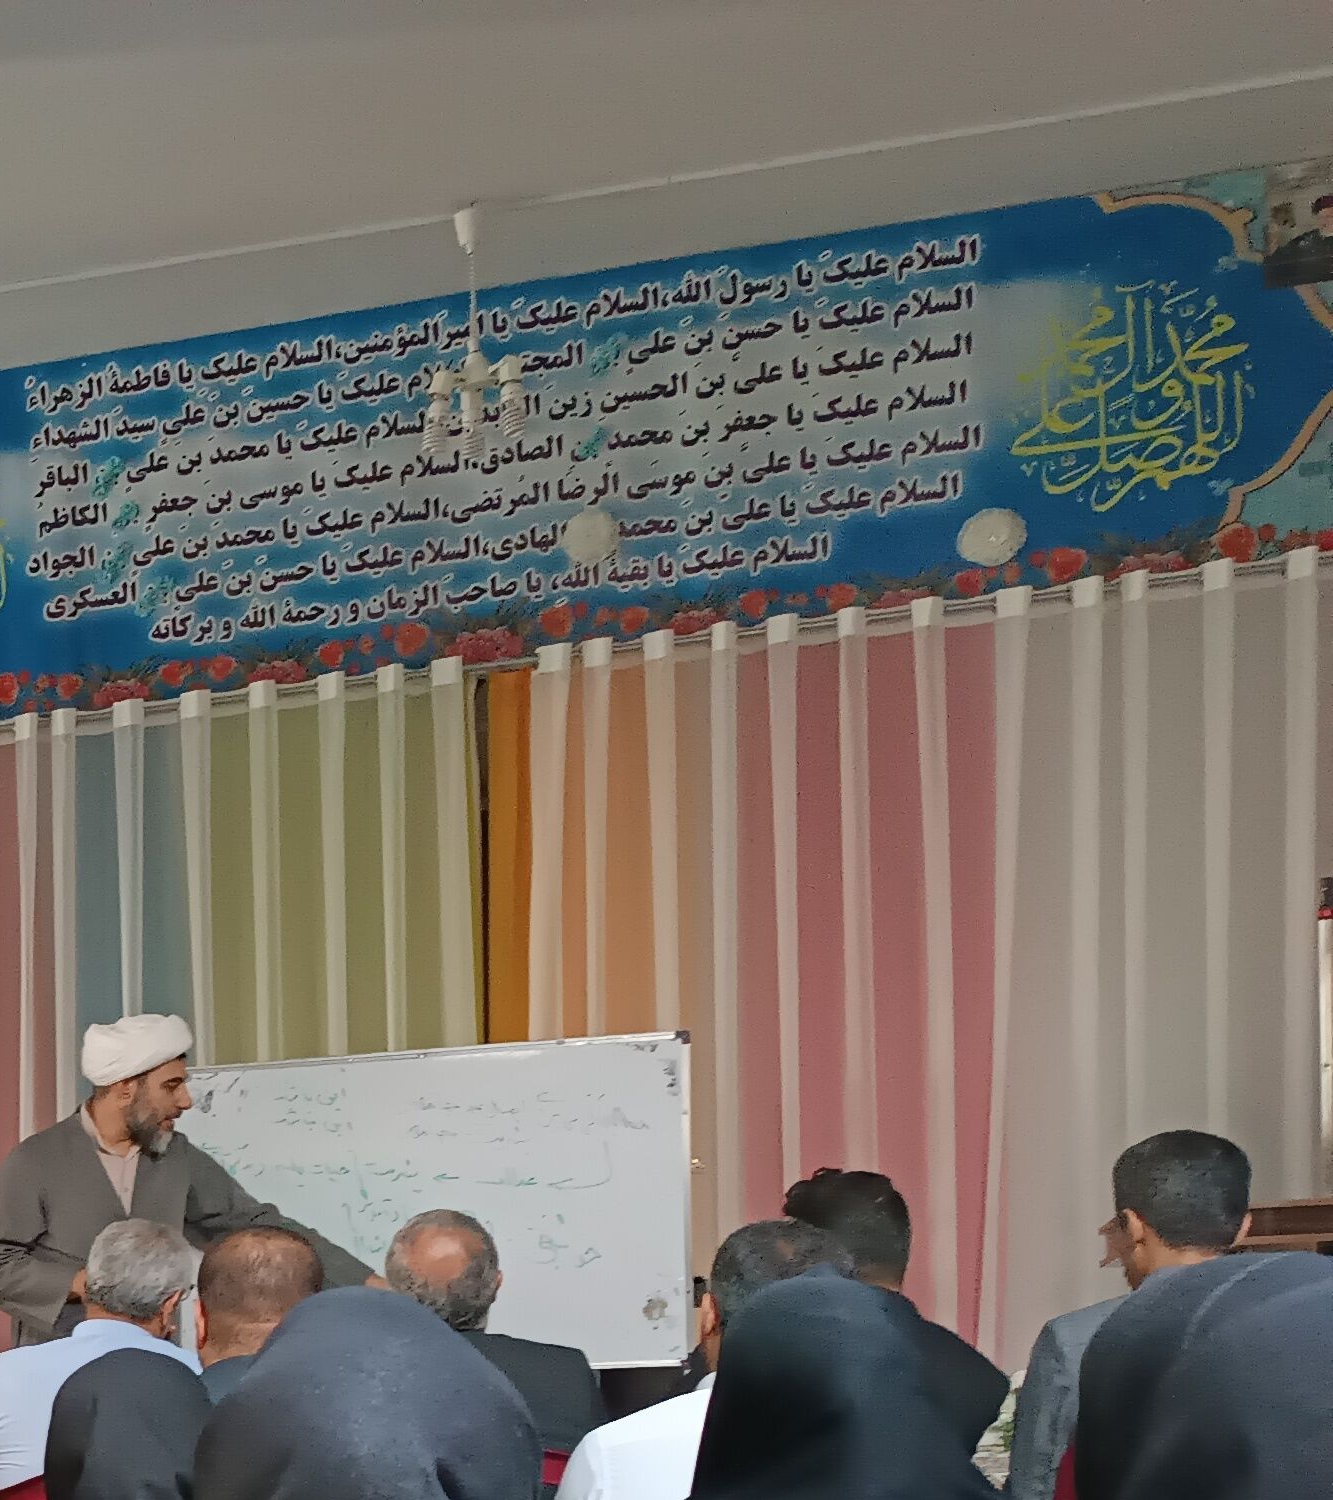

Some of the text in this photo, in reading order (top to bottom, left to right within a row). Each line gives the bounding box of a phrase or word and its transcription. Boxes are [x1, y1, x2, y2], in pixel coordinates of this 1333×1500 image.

[898, 237, 977, 280] السلام
[796, 264, 813, 292] یا
[893, 285, 973, 328] السلام
[492, 312, 507, 339] یا
[793, 310, 809, 338] یا
[893, 332, 972, 373] السلام
[178, 361, 192, 389] یا
[792, 355, 809, 385] یا
[318, 382, 332, 410] یا
[888, 379, 967, 420] السلام
[787, 402, 804, 431] یا
[277, 431, 292, 462] یا
[900, 424, 981, 465] السلام
[799, 446, 817, 475] یا
[240, 479, 303, 510] موسی
[311, 470, 326, 497] یا
[879, 472, 960, 515] السلام
[779, 494, 796, 524] یا
[283, 517, 298, 546] یا
[28, 545, 95, 579] الجواد
[322, 555, 337, 582] یا
[753, 535, 829, 573] السلام
[658, 555, 674, 583] یا
[526, 569, 542, 599] یا
[46, 581, 137, 619] العسکری
[350, 602, 361, 622] و
[367, 583, 439, 617] الزمان
[151, 614, 213, 643] برکاته
[220, 619, 232, 640] و
[240, 602, 276, 629] الله
